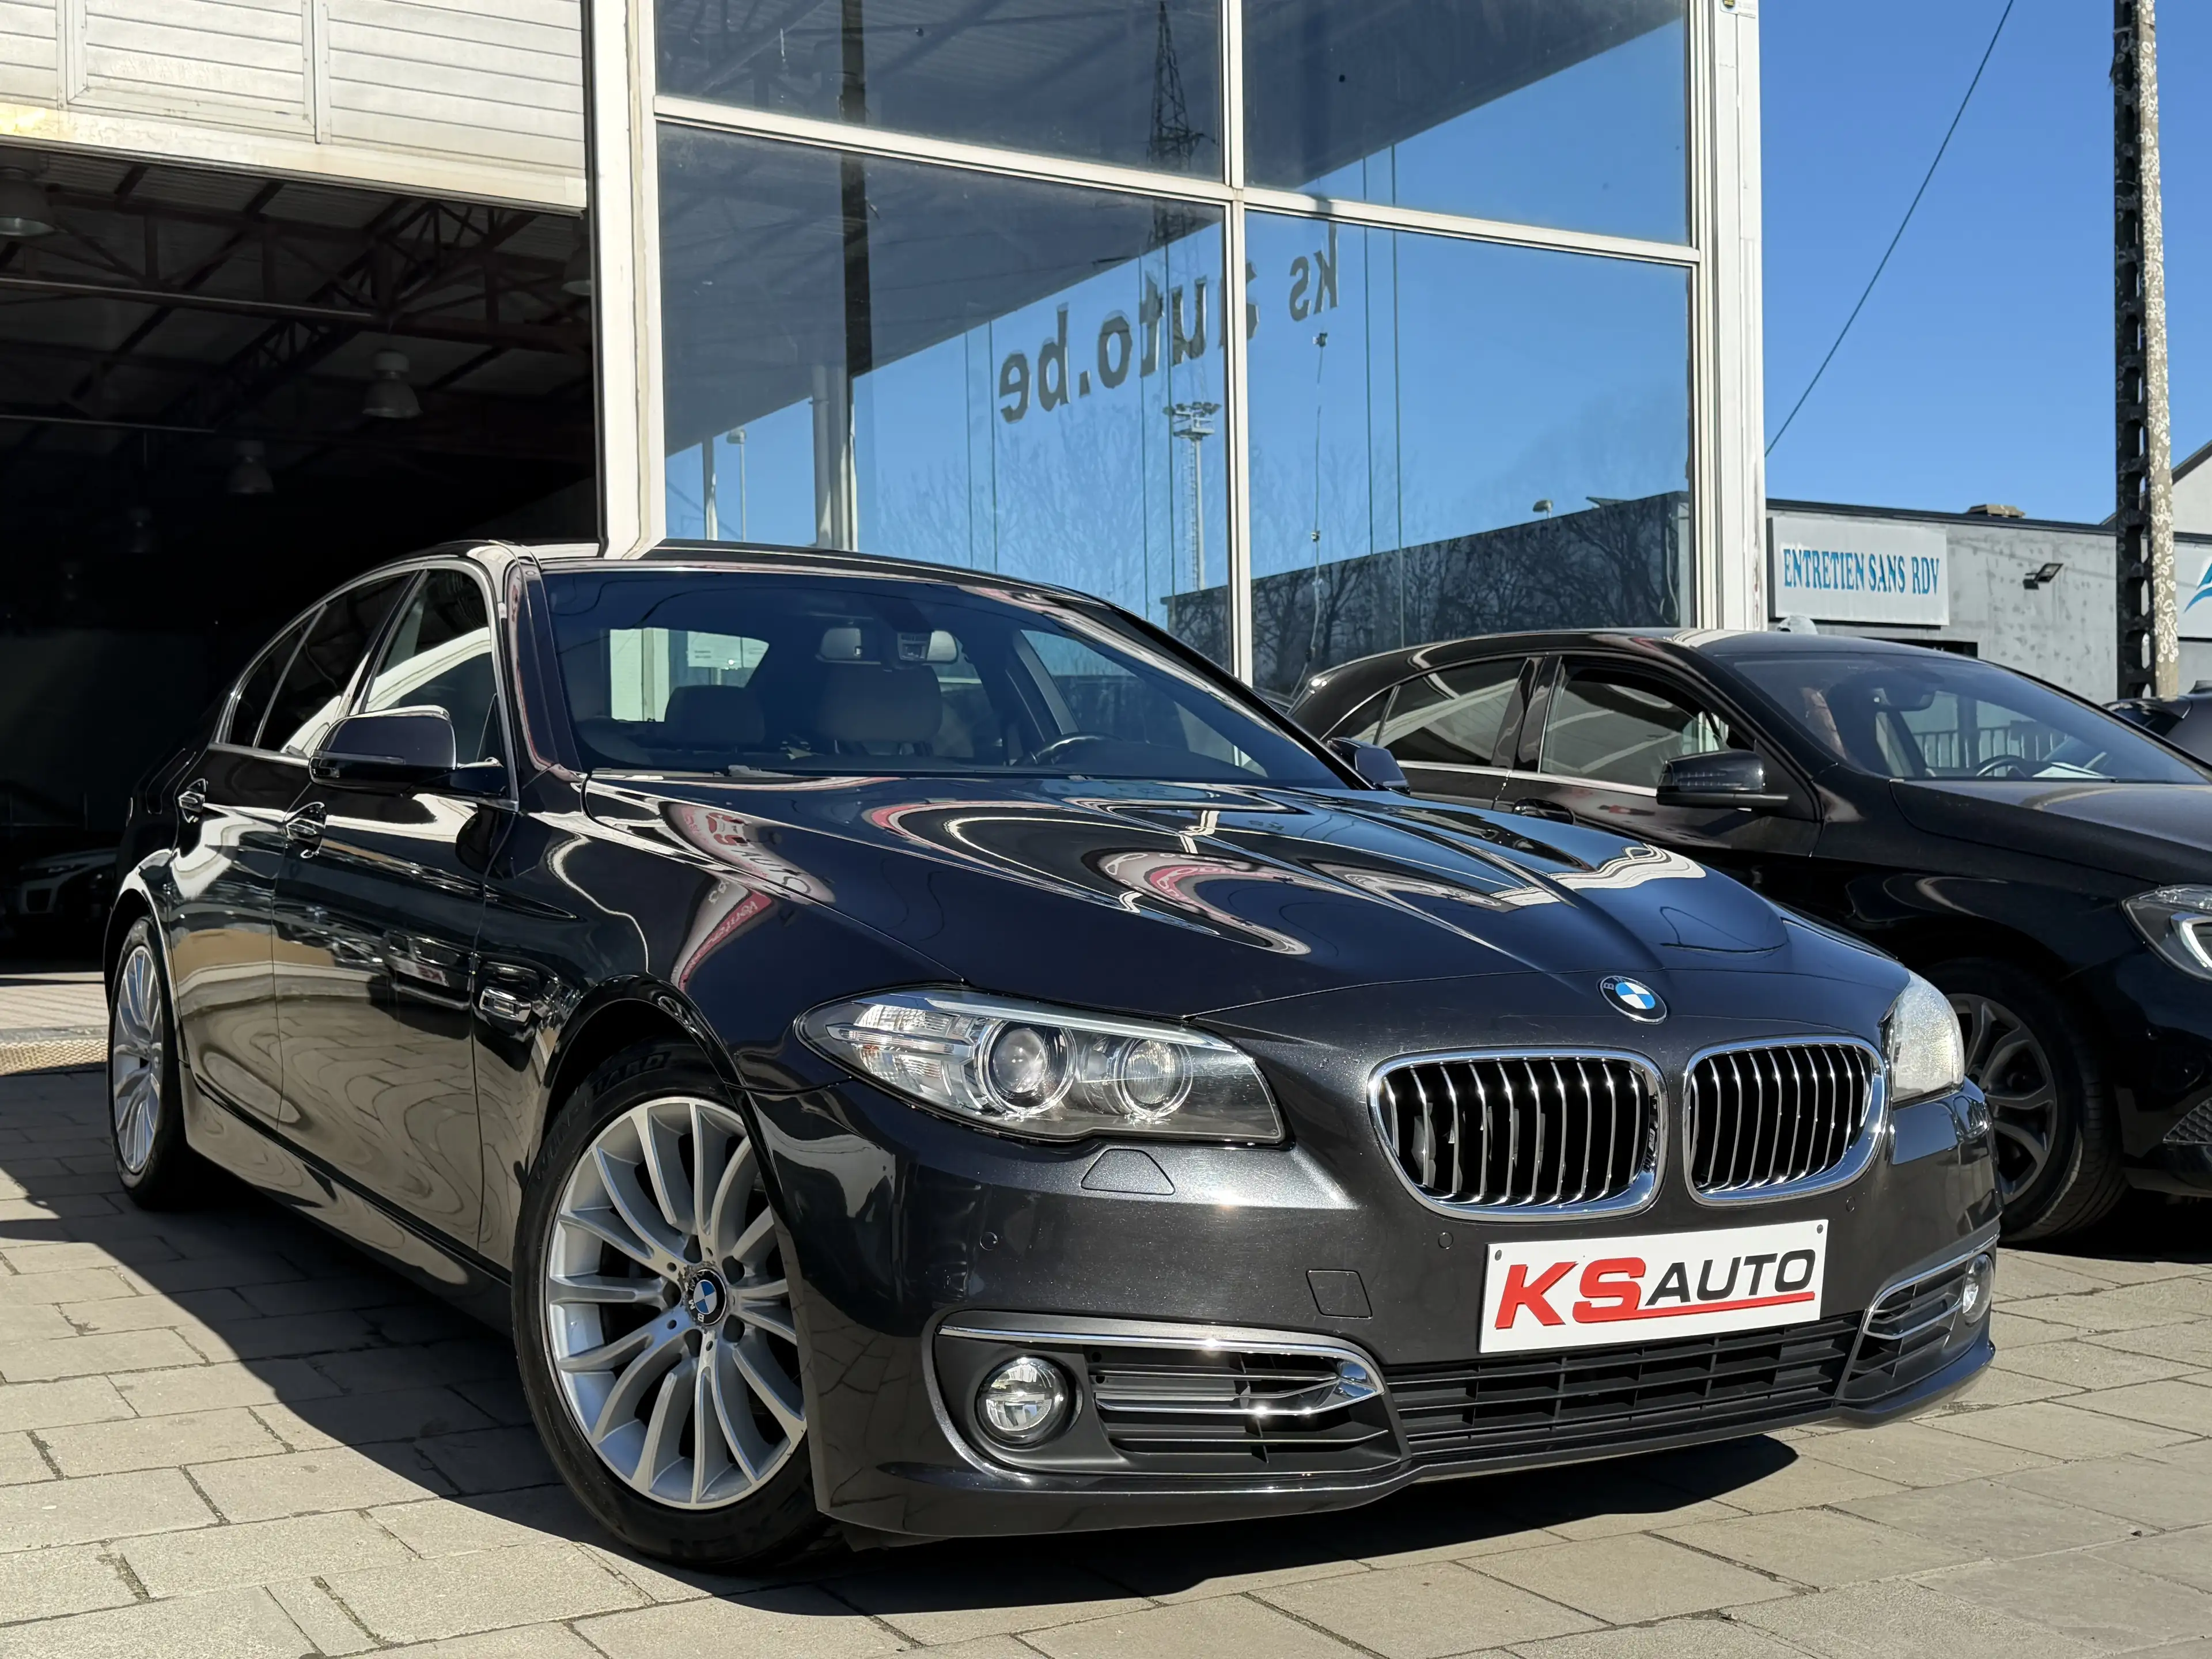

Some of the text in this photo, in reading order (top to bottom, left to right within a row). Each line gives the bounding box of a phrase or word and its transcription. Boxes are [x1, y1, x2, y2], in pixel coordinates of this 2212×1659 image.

[1783, 548, 1940, 596] ENTRETIEN SANS RDV
